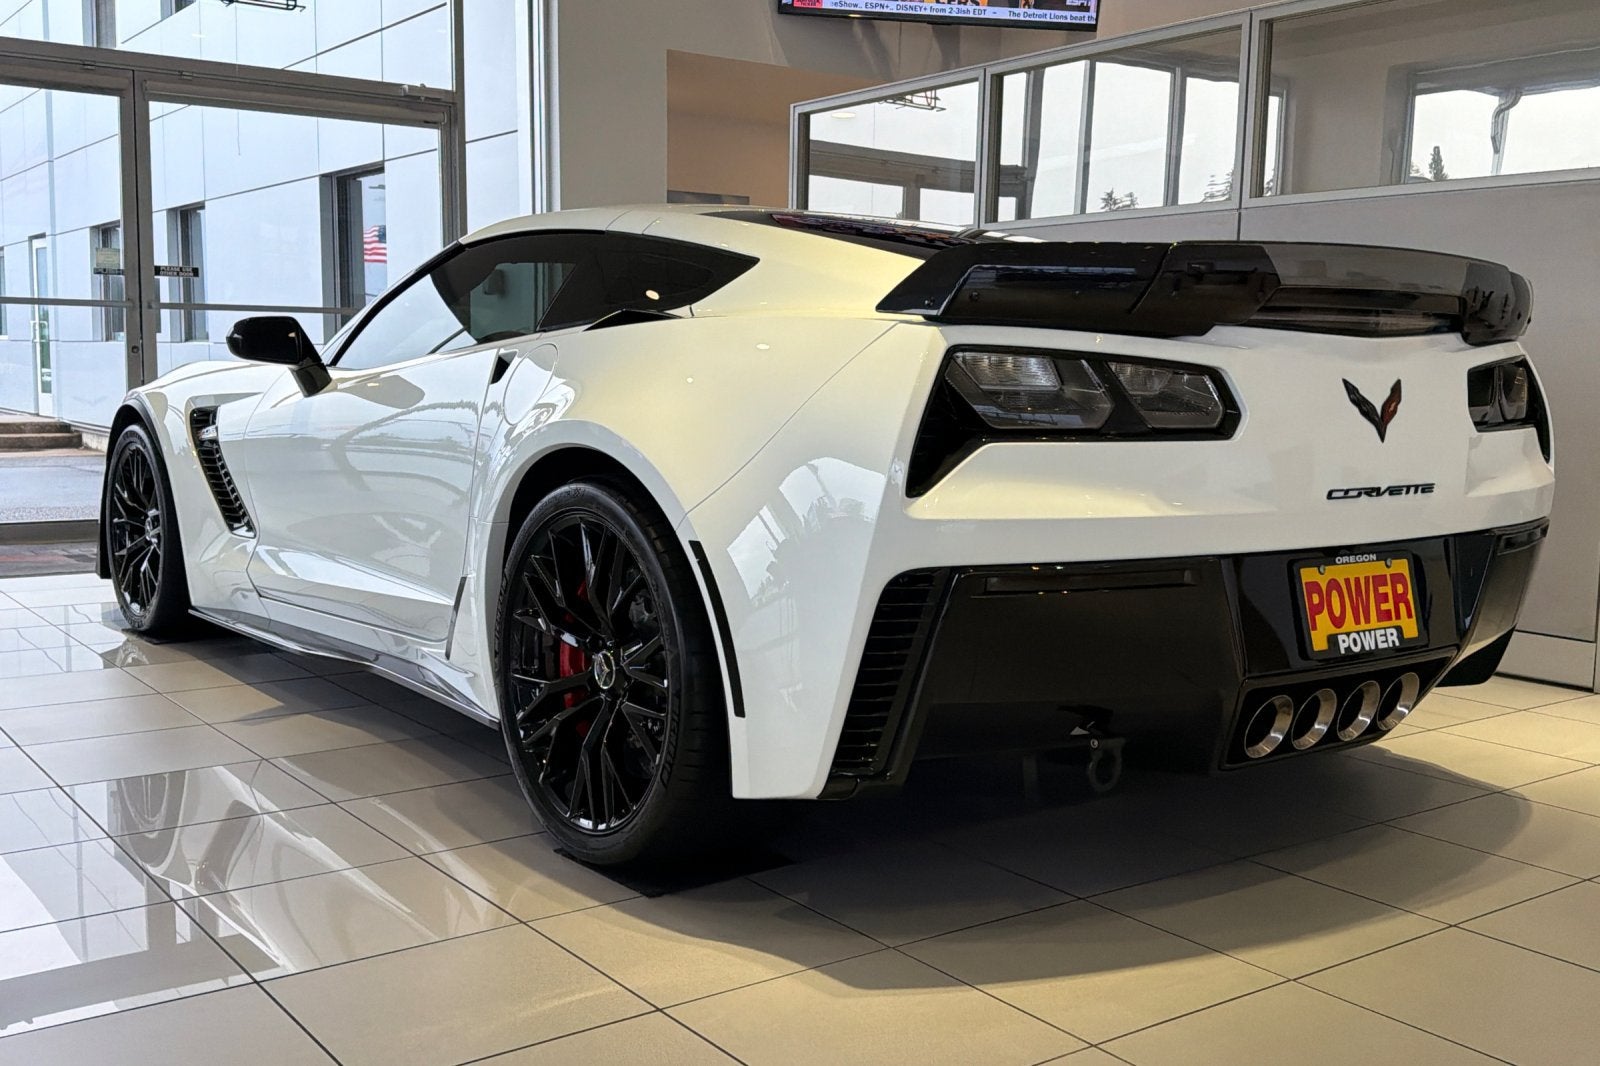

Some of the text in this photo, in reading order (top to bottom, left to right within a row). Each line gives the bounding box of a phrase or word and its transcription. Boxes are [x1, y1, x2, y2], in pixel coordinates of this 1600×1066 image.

[896, 3, 928, 12] DISNEY+
[929, 6, 947, 14] from
[948, 6, 971, 15] 2-3ish
[1008, 10, 1021, 18] The
[1023, 11, 1048, 19] Detroit
[1049, 12, 1068, 20] Lions
[1326, 482, 1435, 500] CORVETTE
[1335, 553, 1377, 564] OREGON
[1304, 572, 1413, 631] POWER
[1337, 628, 1400, 654] POWER
